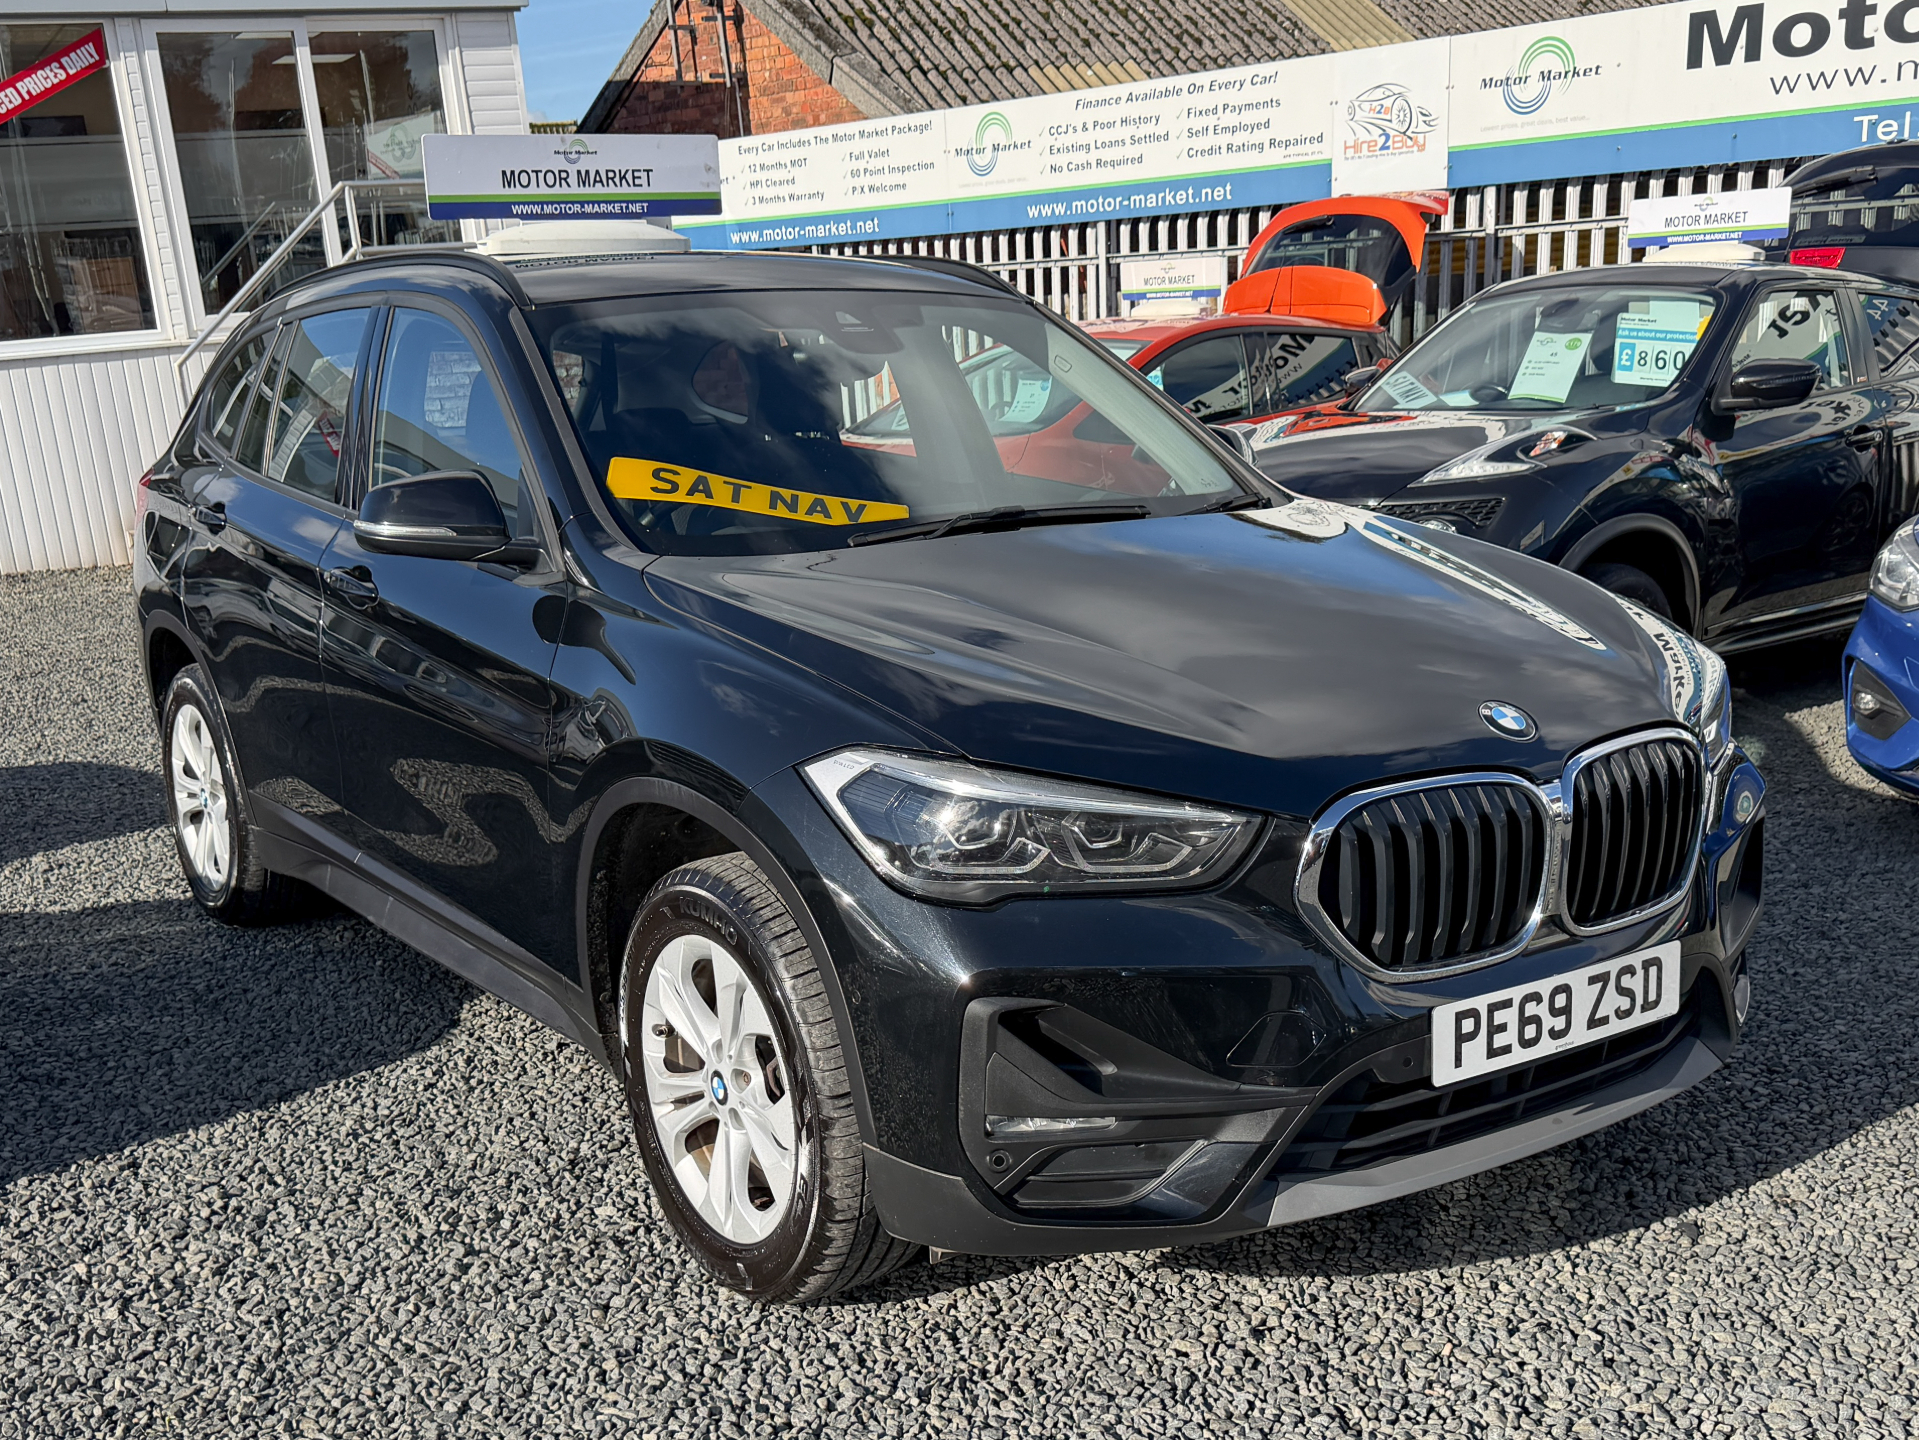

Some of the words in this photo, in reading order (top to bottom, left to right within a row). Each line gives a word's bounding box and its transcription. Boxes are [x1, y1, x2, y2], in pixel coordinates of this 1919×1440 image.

[15, 62, 67, 100] PRICES
[60, 42, 100, 76] DAILY
[1480, 75, 1531, 90] Motor
[1537, 64, 1603, 83] Market
[1075, 96, 1122, 111] Finance
[1125, 85, 1183, 104] Available
[1187, 82, 1204, 95] On
[1208, 78, 1246, 92] Every
[1250, 71, 1279, 87] Car!
[1187, 104, 1218, 119] Fixed
[1222, 97, 1281, 116] Payments
[1048, 123, 1077, 136] CCJ's
[1081, 121, 1089, 133] &
[1093, 119, 1117, 131] Poor
[1120, 114, 1160, 127] History
[1187, 125, 1209, 139] Self
[1213, 118, 1270, 136] Employed
[738, 145, 759, 156] Every
[761, 142, 775, 152] Car
[777, 138, 812, 150] Includes
[813, 135, 829, 146] The
[832, 133, 856, 143] Motor
[858, 128, 889, 140] Market
[891, 119, 933, 135] Package!
[1049, 141, 1091, 155] Existing
[1094, 139, 1126, 150] Loans
[1130, 130, 1169, 146] Settled
[1187, 144, 1222, 159] Credit
[1226, 140, 1264, 153] Rating
[1269, 132, 1324, 150] Repaired
[1344, 132, 1427, 155] Hire2Buy
[849, 150, 865, 162] Full
[867, 148, 890, 159] Valet
[954, 146, 987, 158] Motor
[992, 140, 1032, 153] Market
[748, 163, 757, 173] 12
[759, 160, 788, 172] Months
[790, 157, 807, 168] MOT
[850, 168, 860, 178] 60
[863, 165, 885, 177] Point
[888, 160, 935, 175] Inspection
[1050, 163, 1063, 174] No
[1066, 159, 1092, 172] Cash
[1095, 153, 1143, 170] Required
[501, 169, 570, 189] MOTOR
[577, 168, 654, 188] MARKET
[749, 179, 763, 189] HPI
[765, 176, 796, 188] Cleared
[867, 182, 907, 193] Welcome
[511, 202, 649, 215] WWW.MOTOR-MARKET.NET
[752, 196, 757, 206] 3
[758, 193, 786, 205] Months
[788, 190, 825, 202] Warranty
[1027, 182, 1232, 219] www.motor-market.net
[730, 217, 880, 244] www.motor-market.net
[1664, 214, 1701, 229] MOTOR
[1704, 211, 1749, 226] MARKET
[1667, 231, 1743, 243] WWW.MOTOR-MARKET.NET
[1143, 276, 1167, 286] MOTOR
[1168, 274, 1195, 285] MARKET
[649, 467, 752, 505] SAT
[768, 490, 868, 523] NAV
[680, 897, 738, 945] KUMHO
[1453, 983, 1573, 1069] PE69
[1586, 956, 1664, 1031] ZSD
